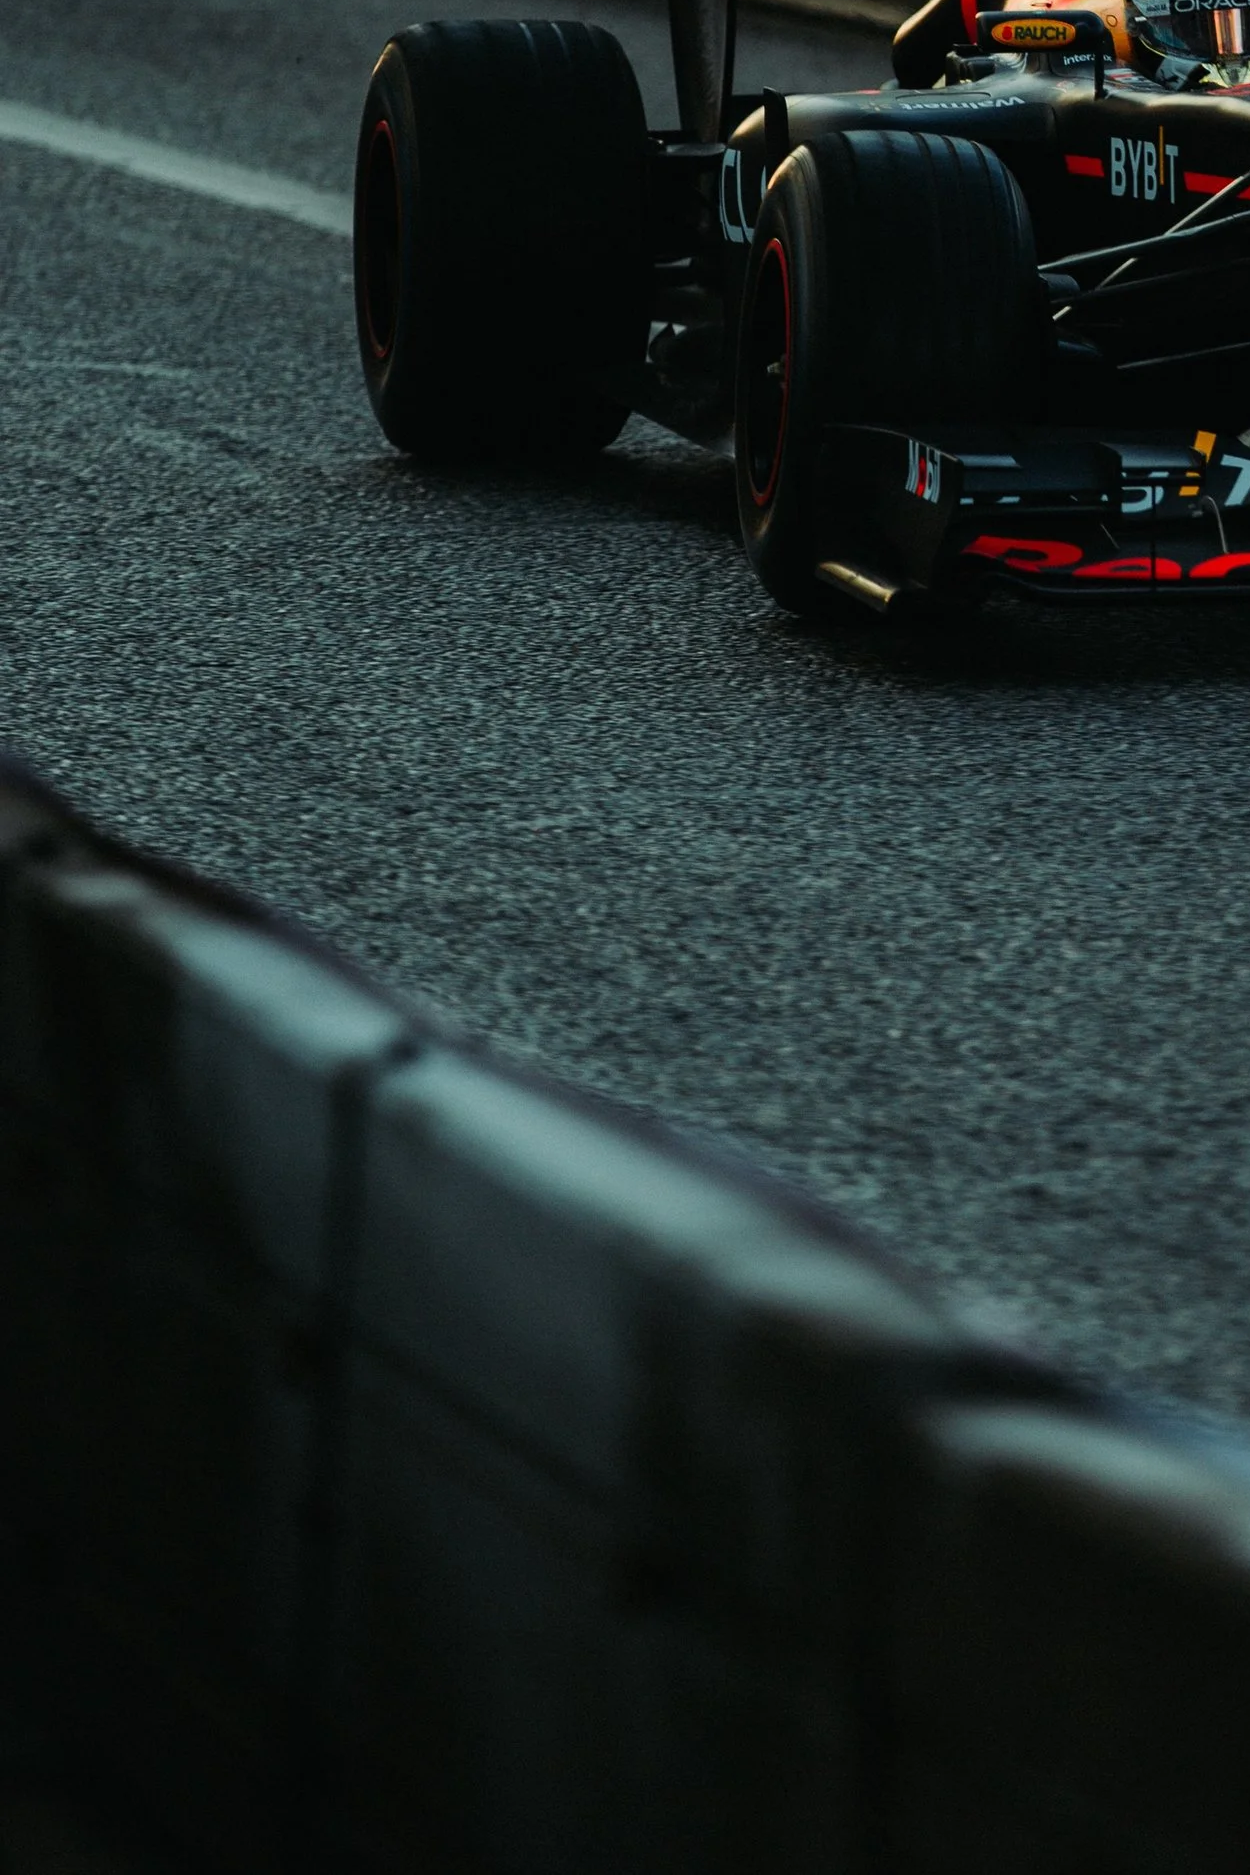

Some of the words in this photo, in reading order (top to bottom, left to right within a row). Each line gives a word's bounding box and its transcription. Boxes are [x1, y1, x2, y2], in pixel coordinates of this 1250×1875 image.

[1015, 27, 1067, 41] RAUCH
[1064, 53, 1112, 66] inter.x
[899, 95, 1026, 111] Walmart
[1110, 125, 1179, 205] BYBIT
